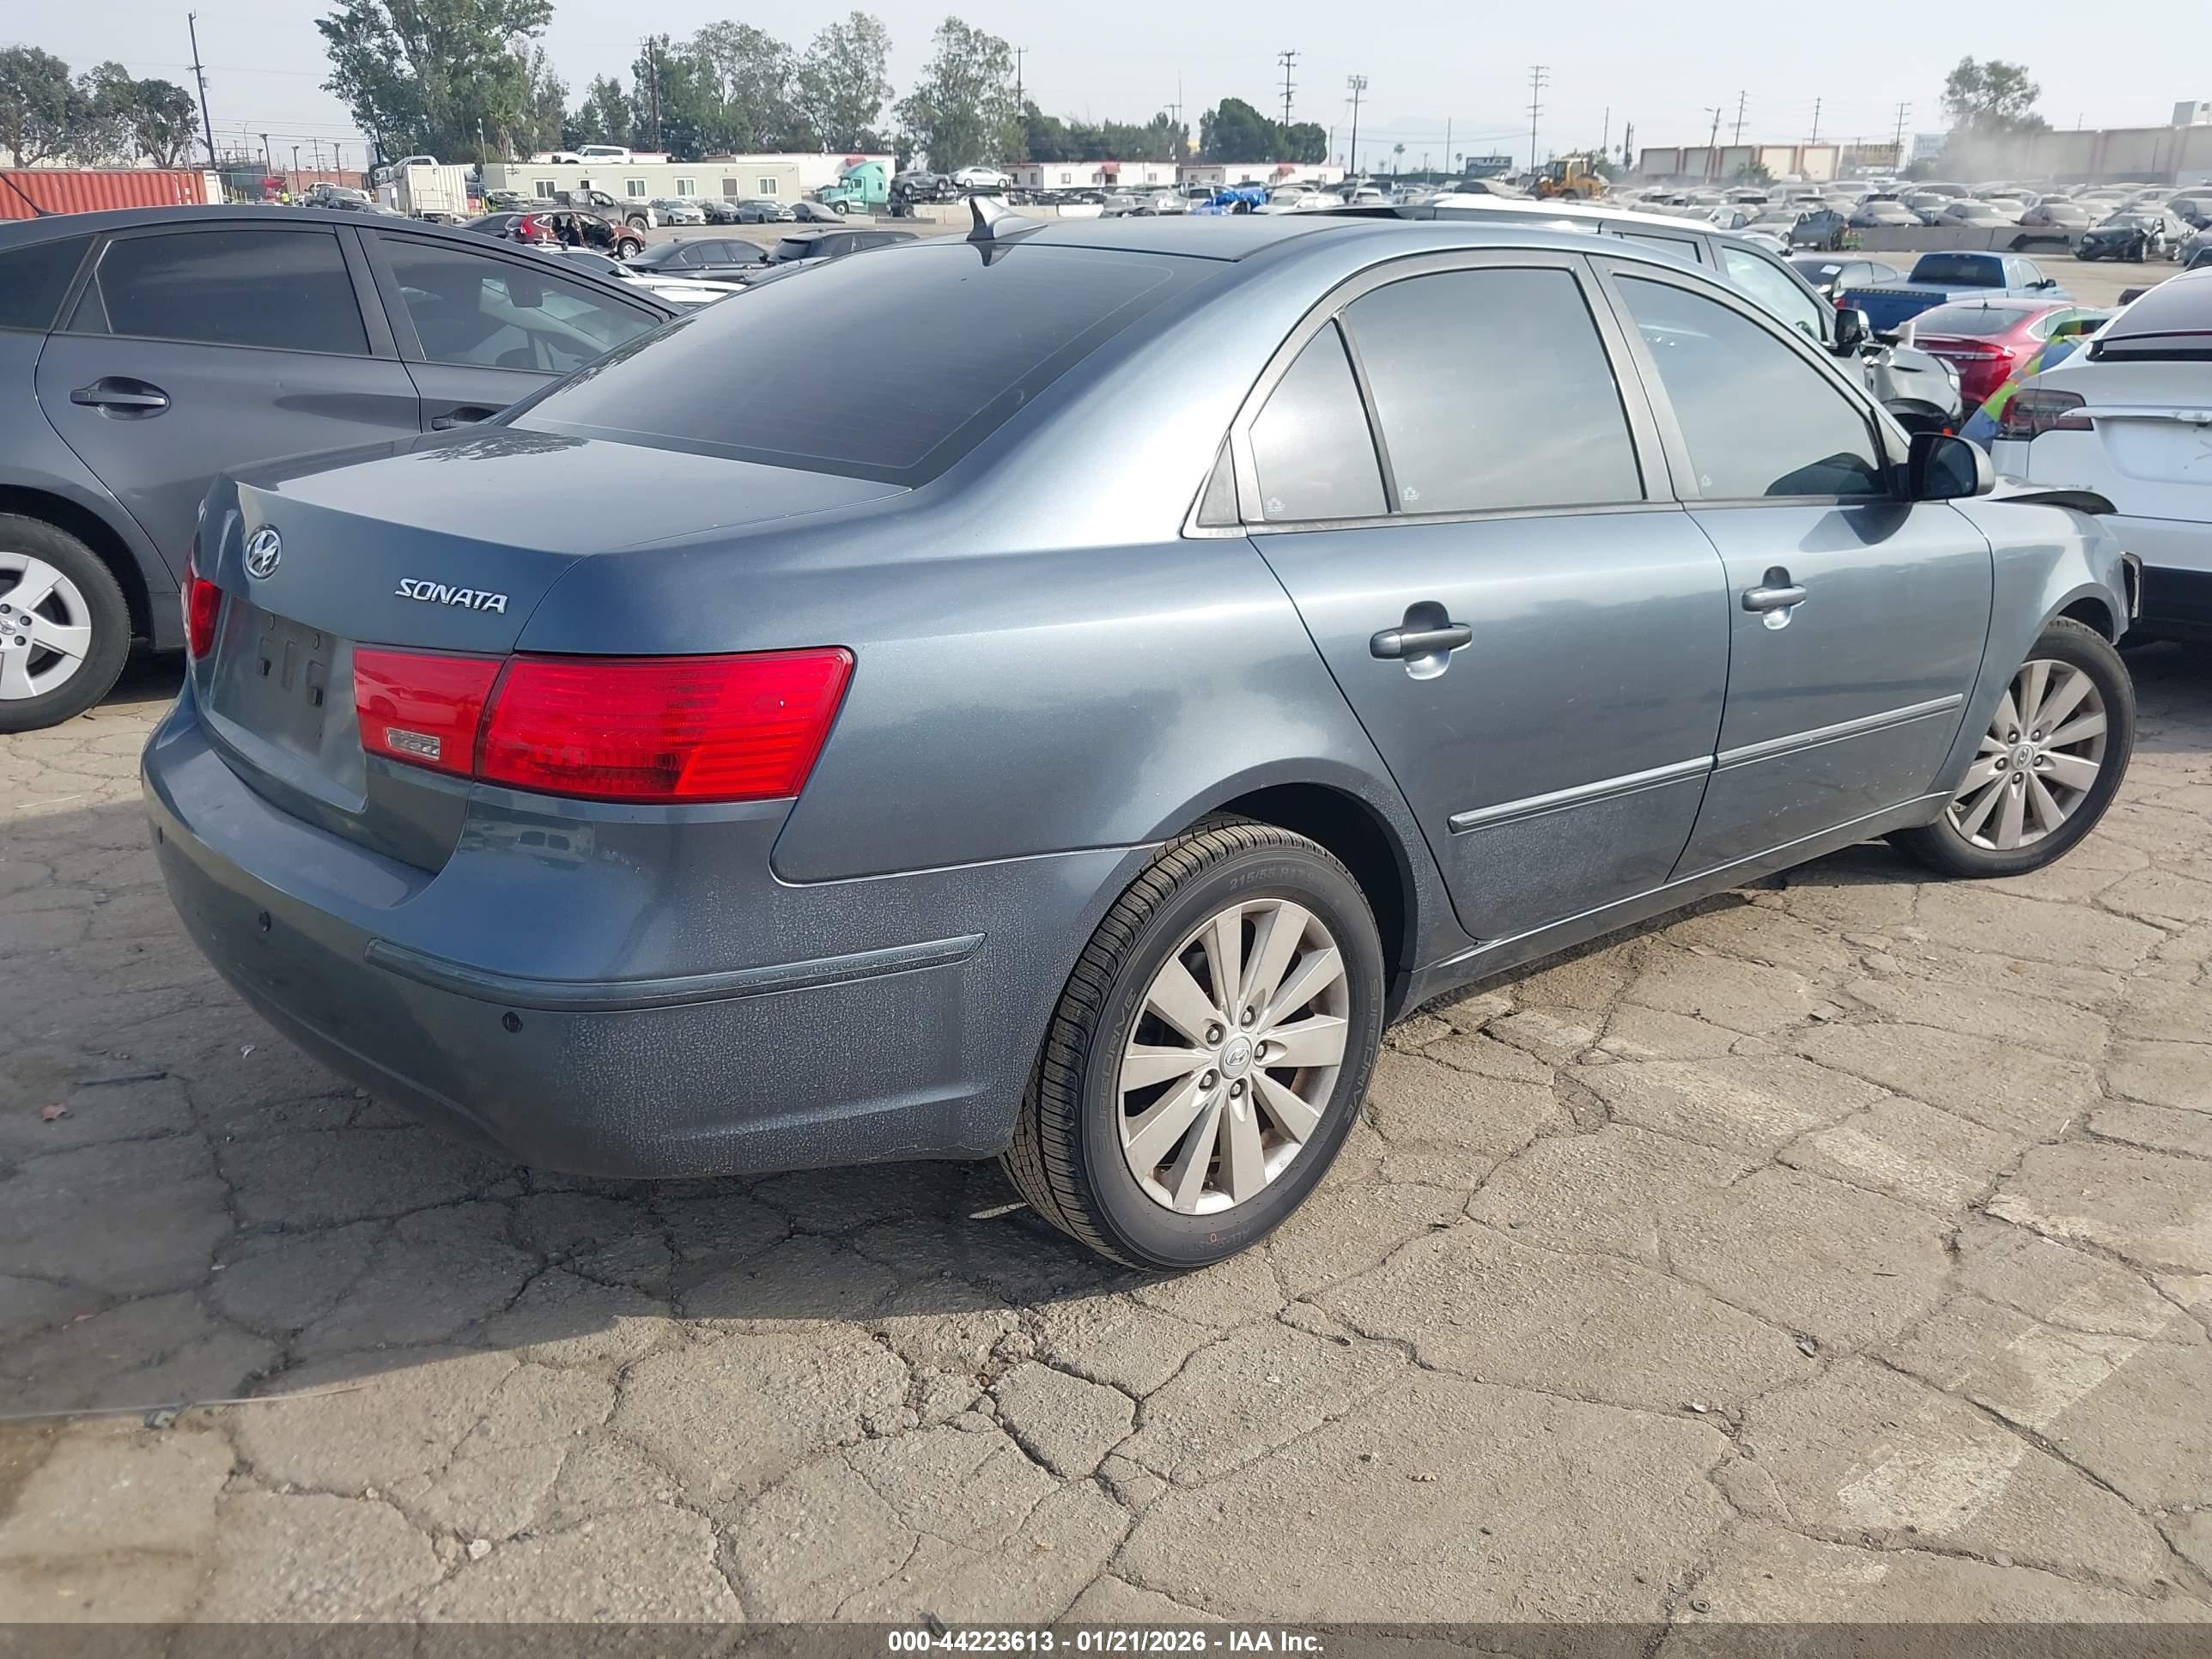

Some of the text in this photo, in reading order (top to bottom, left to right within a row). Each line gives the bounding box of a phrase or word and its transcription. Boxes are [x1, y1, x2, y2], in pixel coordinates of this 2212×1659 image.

[395, 578, 508, 614] SONATA
[1095, 988, 1138, 1155] SUREDRIVE
[1344, 978, 1379, 1123] SUREDRIVE
